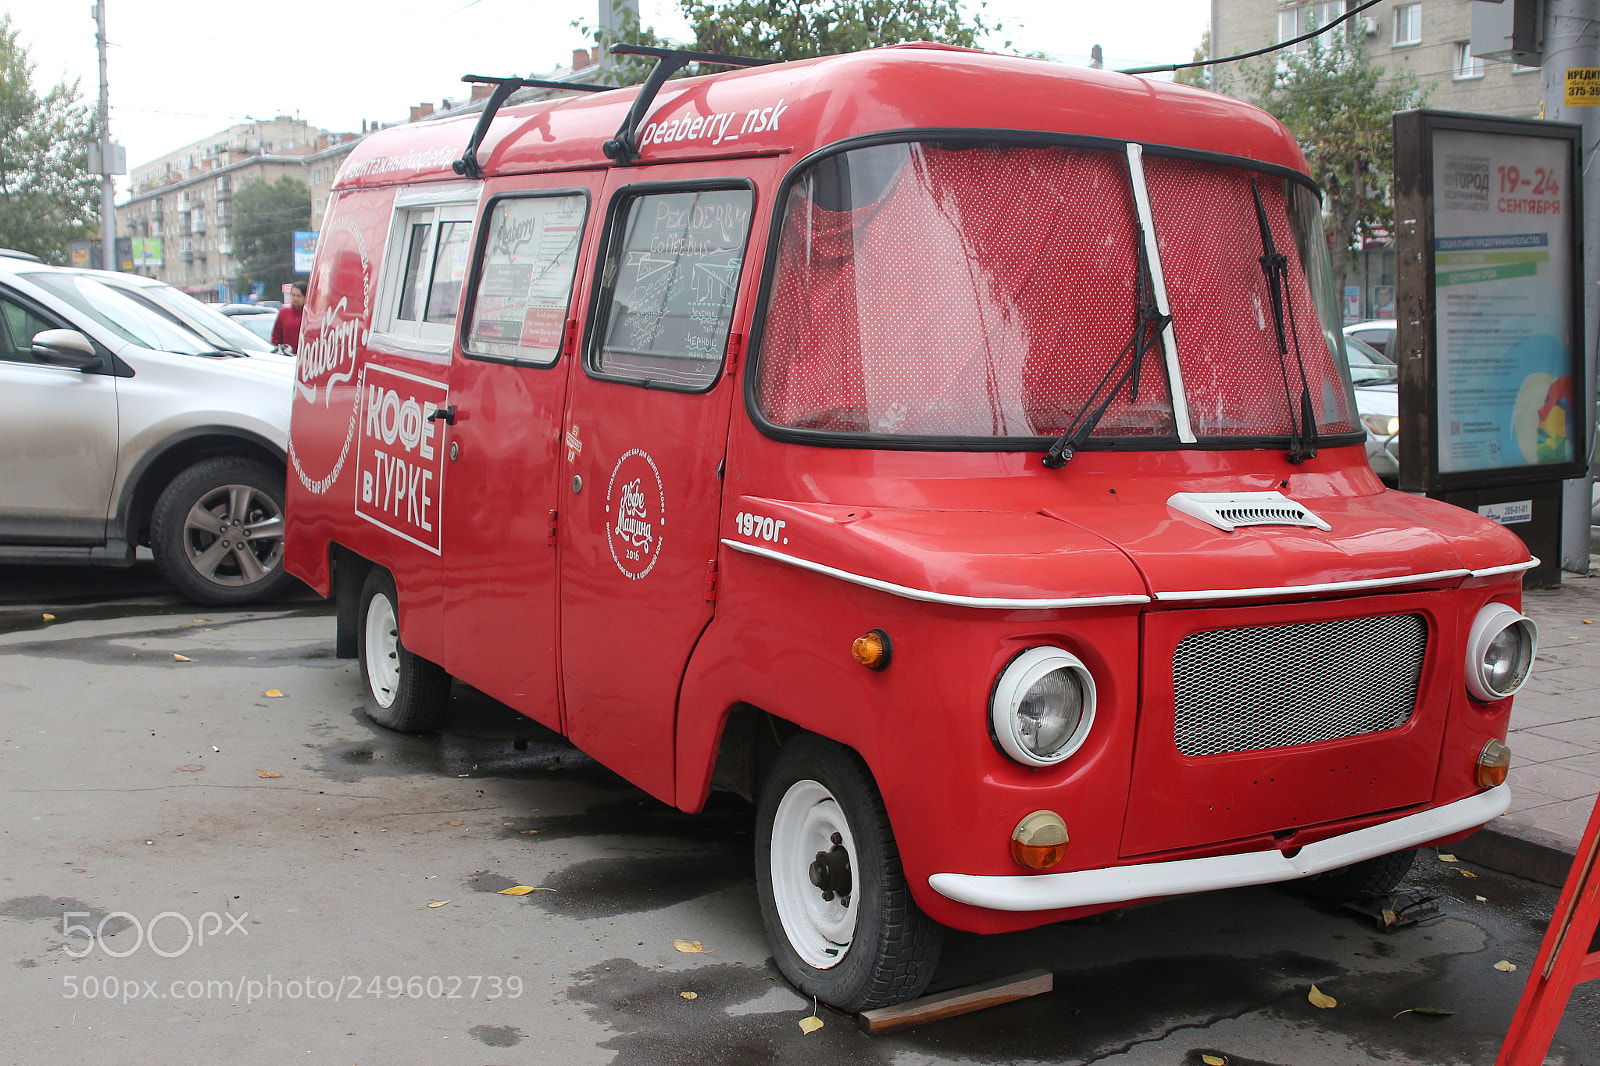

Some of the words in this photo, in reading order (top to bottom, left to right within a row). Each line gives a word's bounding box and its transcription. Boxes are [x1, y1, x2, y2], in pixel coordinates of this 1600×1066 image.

[638, 98, 788, 154] peaberry_nsk
[1454, 173, 1490, 193] ГОРОД
[1498, 165, 1560, 196] 19-24
[1497, 198, 1561, 215] СЕНТЯБРЯ
[312, 480, 322, 494] БАР
[352, 368, 364, 415] КОФЕ
[366, 384, 438, 461] КОФЕ
[625, 549, 640, 562] 2016
